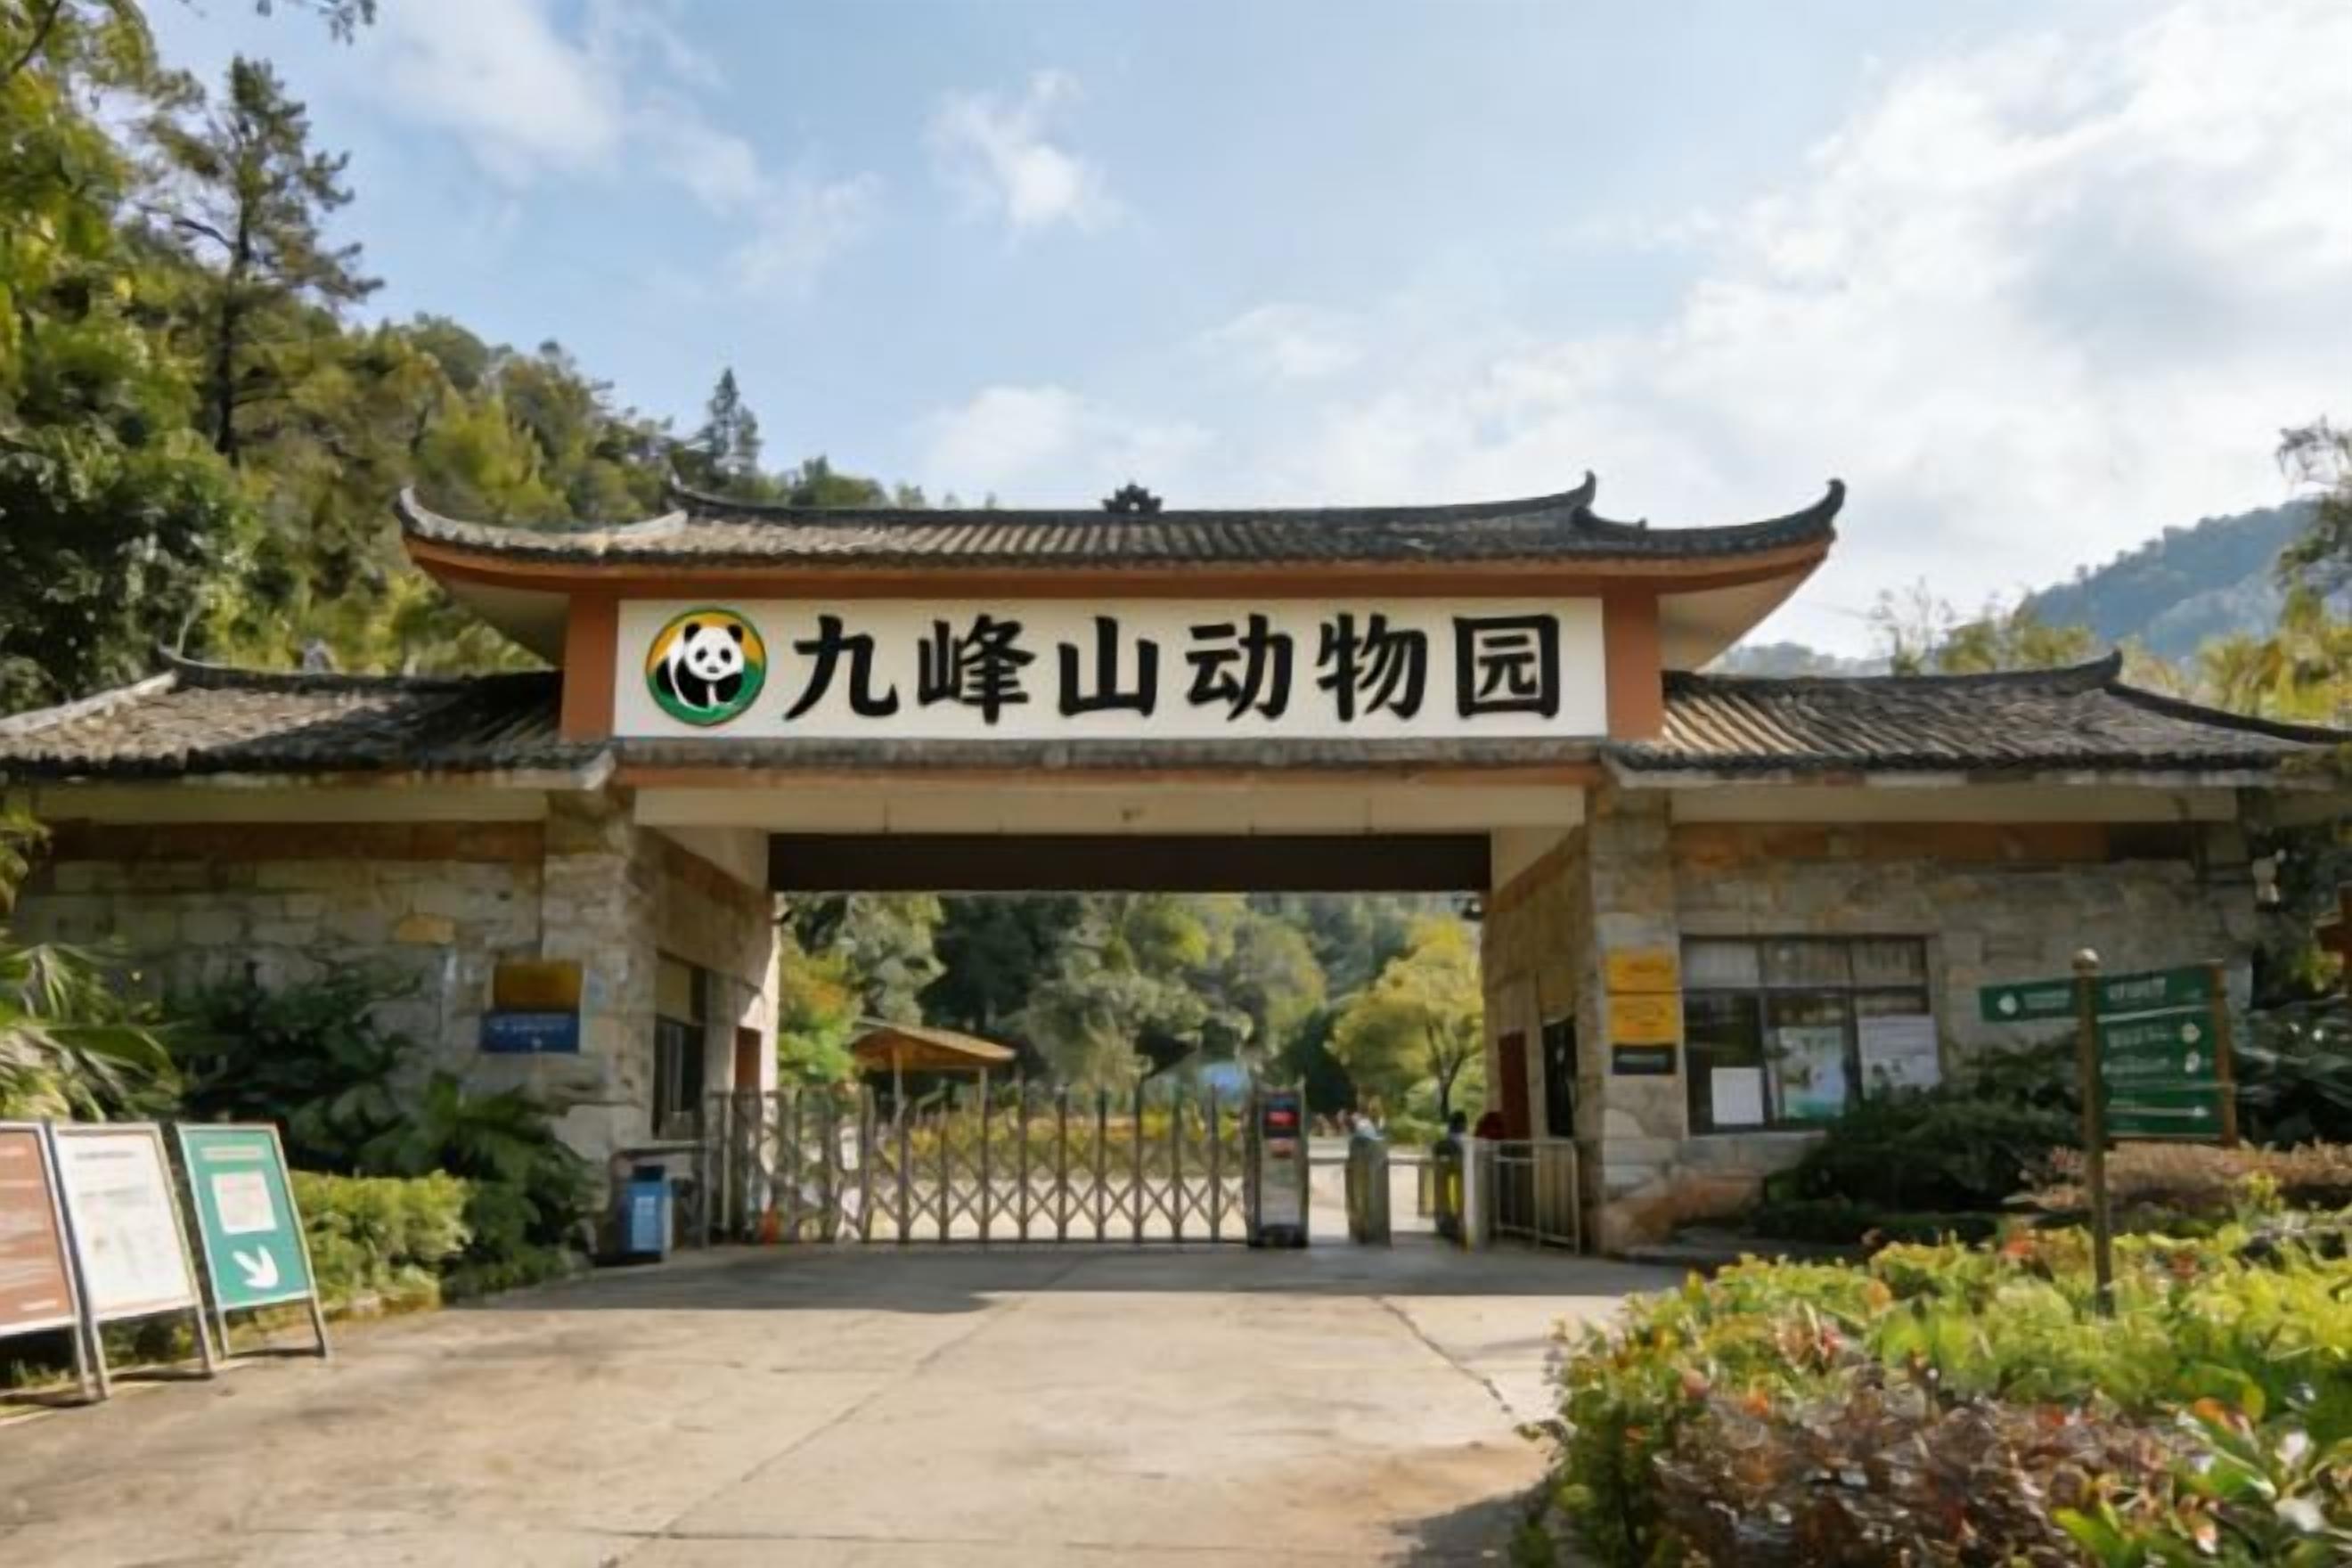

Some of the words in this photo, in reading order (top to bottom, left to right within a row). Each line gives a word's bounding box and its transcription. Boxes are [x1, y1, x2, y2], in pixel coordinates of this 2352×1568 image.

[780, 612, 1562, 725] 九峰山动物园
